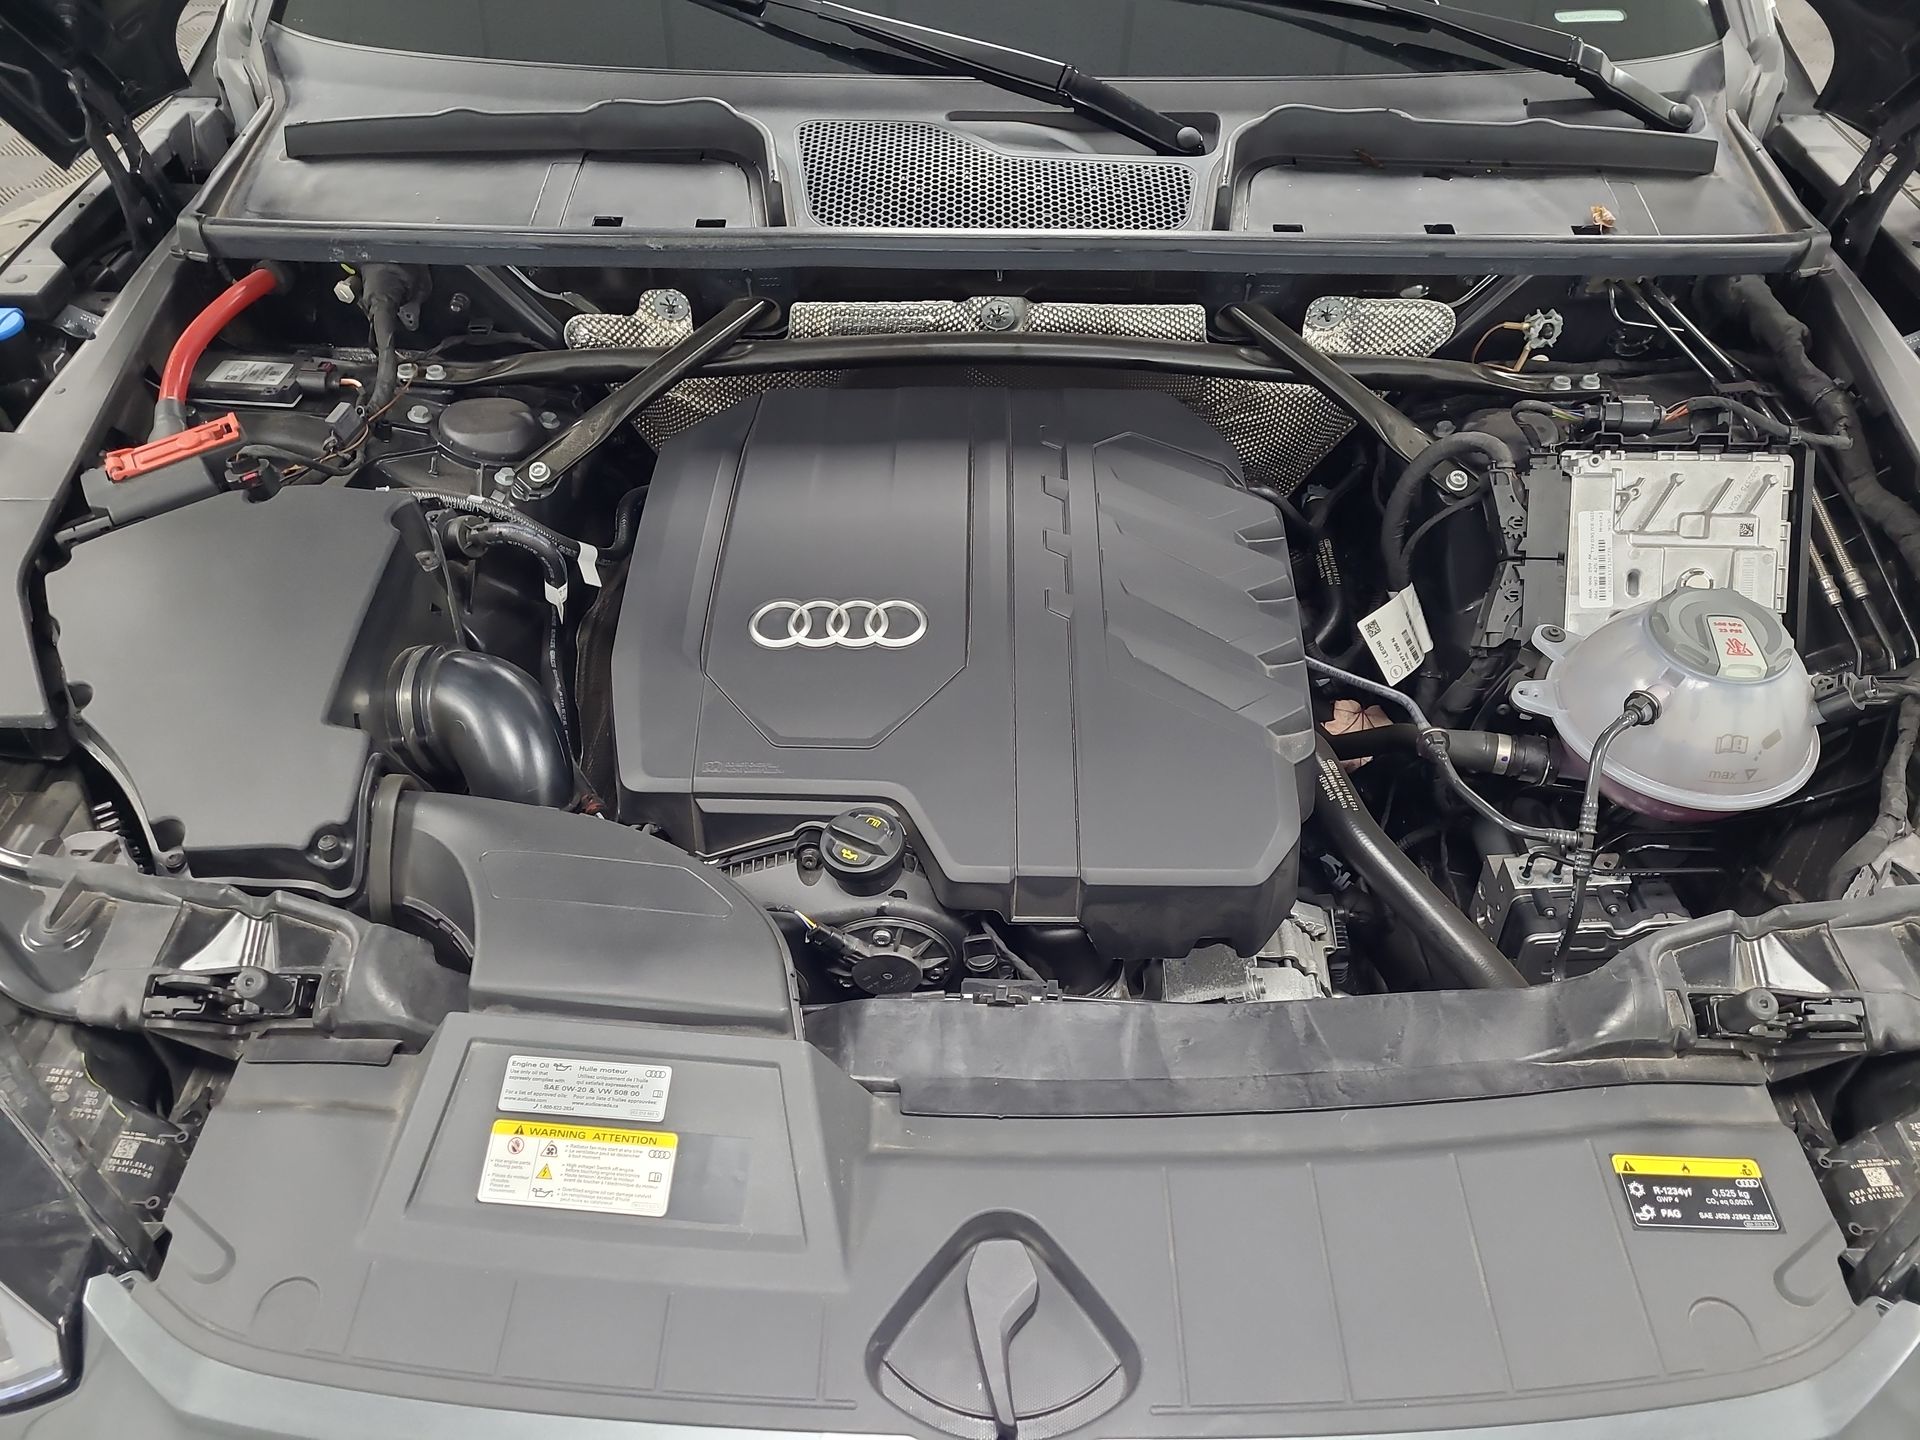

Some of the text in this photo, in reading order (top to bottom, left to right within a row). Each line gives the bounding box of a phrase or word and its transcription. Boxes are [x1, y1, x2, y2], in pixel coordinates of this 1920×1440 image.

[1376, 640, 1389, 658] LEONI
[1709, 770, 1737, 780] max
[511, 1060, 537, 1068] Engine
[561, 1085, 587, 1093] 0W-20
[529, 1127, 658, 1145] WARNING ATTENTION
[1653, 1186, 1693, 1198] R-1234yf
[1711, 1188, 1750, 1199] 0,525 kg
[1660, 1209, 1682, 1218] PAG
[1698, 1212, 1713, 1220] SAE
